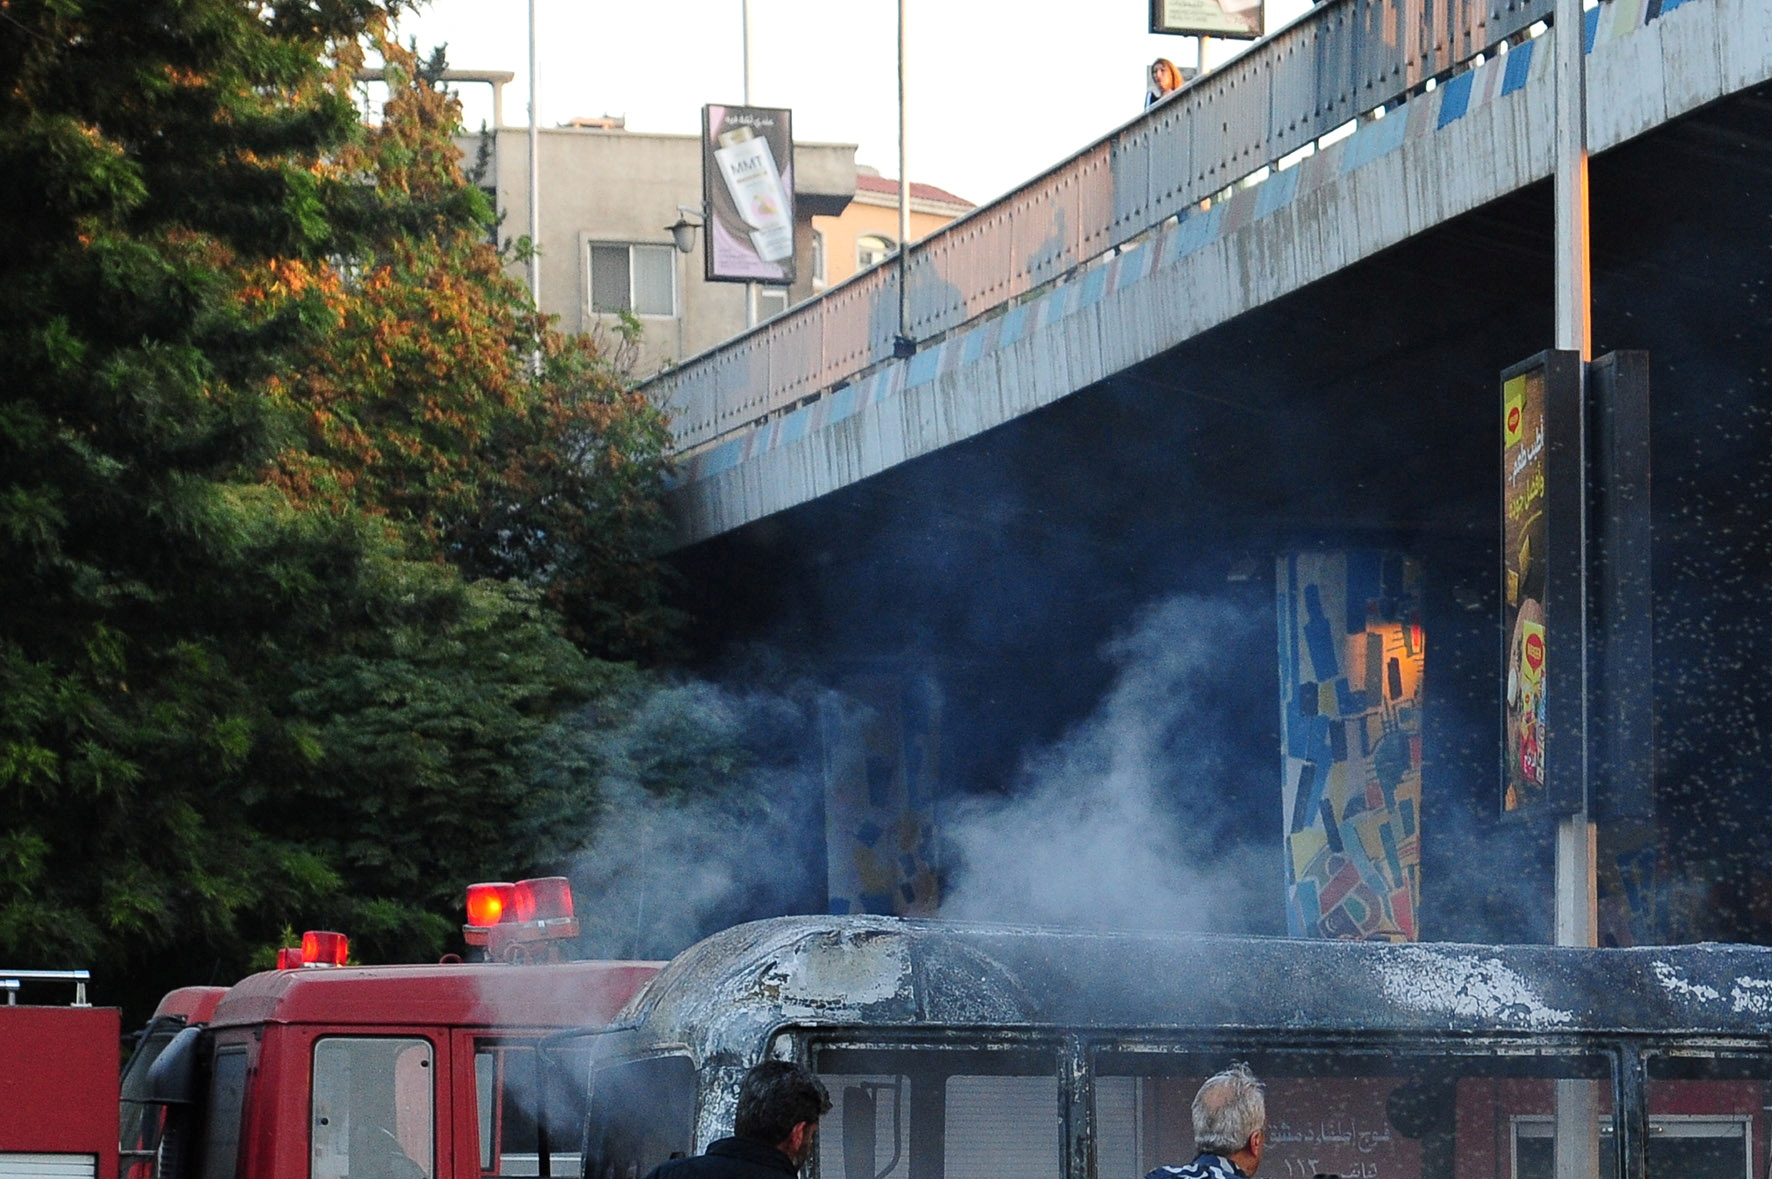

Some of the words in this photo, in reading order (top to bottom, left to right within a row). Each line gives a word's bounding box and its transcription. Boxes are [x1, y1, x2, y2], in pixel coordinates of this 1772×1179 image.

[1527, 414, 1544, 466] أطيب
[1264, 1122, 1316, 1150] دمشق
[1358, 1121, 1391, 1153] فوج
